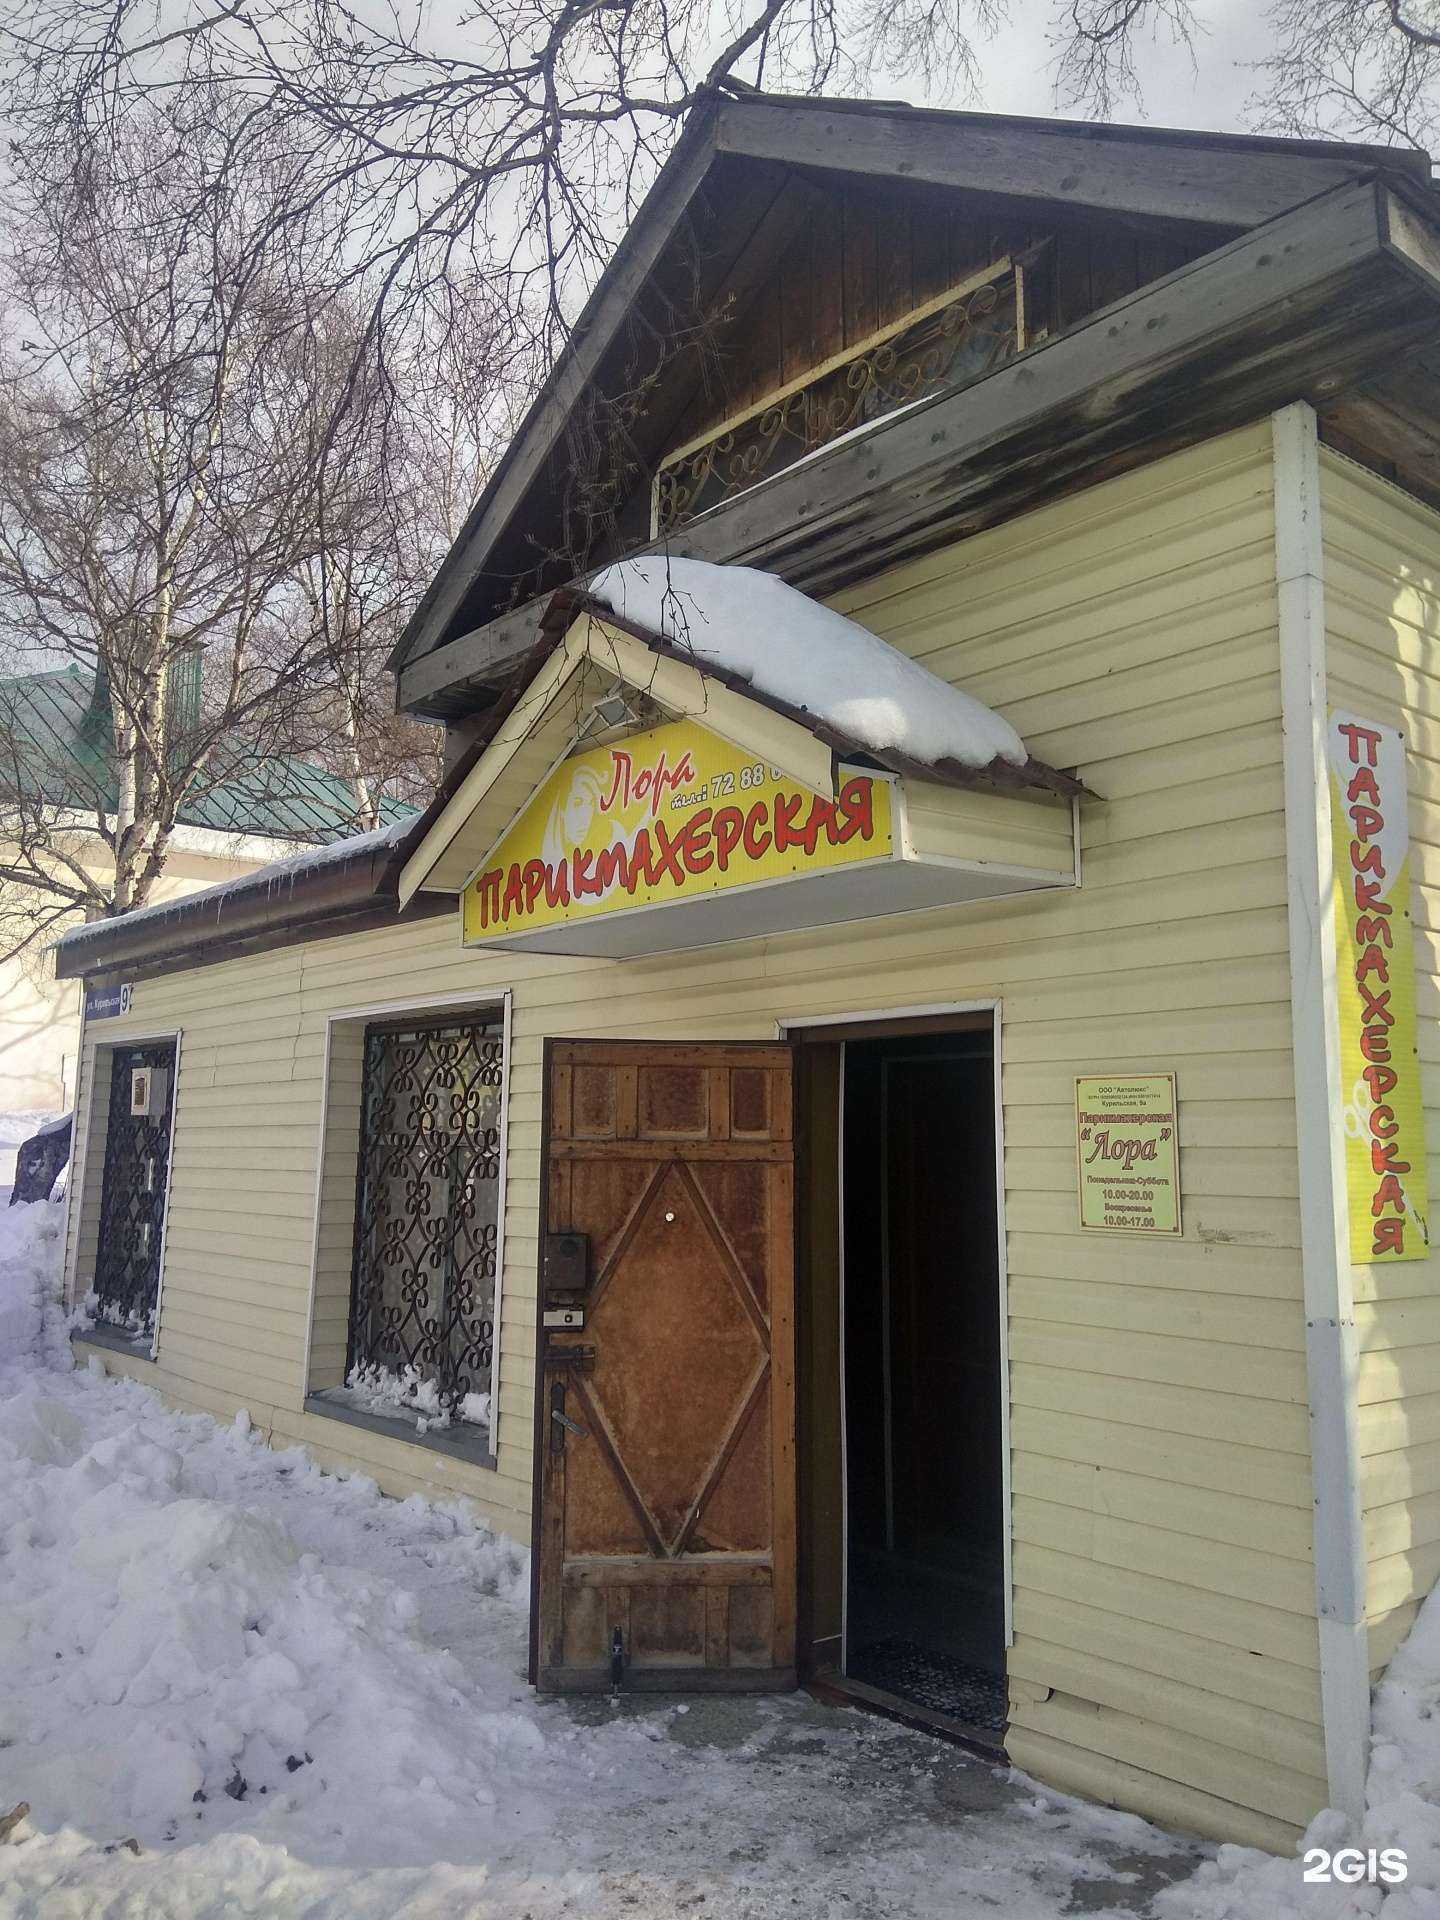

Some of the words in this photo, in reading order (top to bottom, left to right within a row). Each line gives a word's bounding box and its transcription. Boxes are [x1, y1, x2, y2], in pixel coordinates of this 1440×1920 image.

[600, 751, 695, 817] Лора
[711, 772, 736, 799] 72
[740, 762, 765, 790] 88
[476, 775, 874, 929] ПАРИКМАХЕРСКАЯ
[1338, 723, 1411, 1255] ПАРИКМАХЕРСКАЯ
[1098, 1086, 1113, 1094] ООО
[1080, 1111, 1174, 1126] Парикмахерская
[1102, 1188, 1154, 1201] 10.00-20.00
[1103, 1215, 1156, 1228] 10.00-17.00
